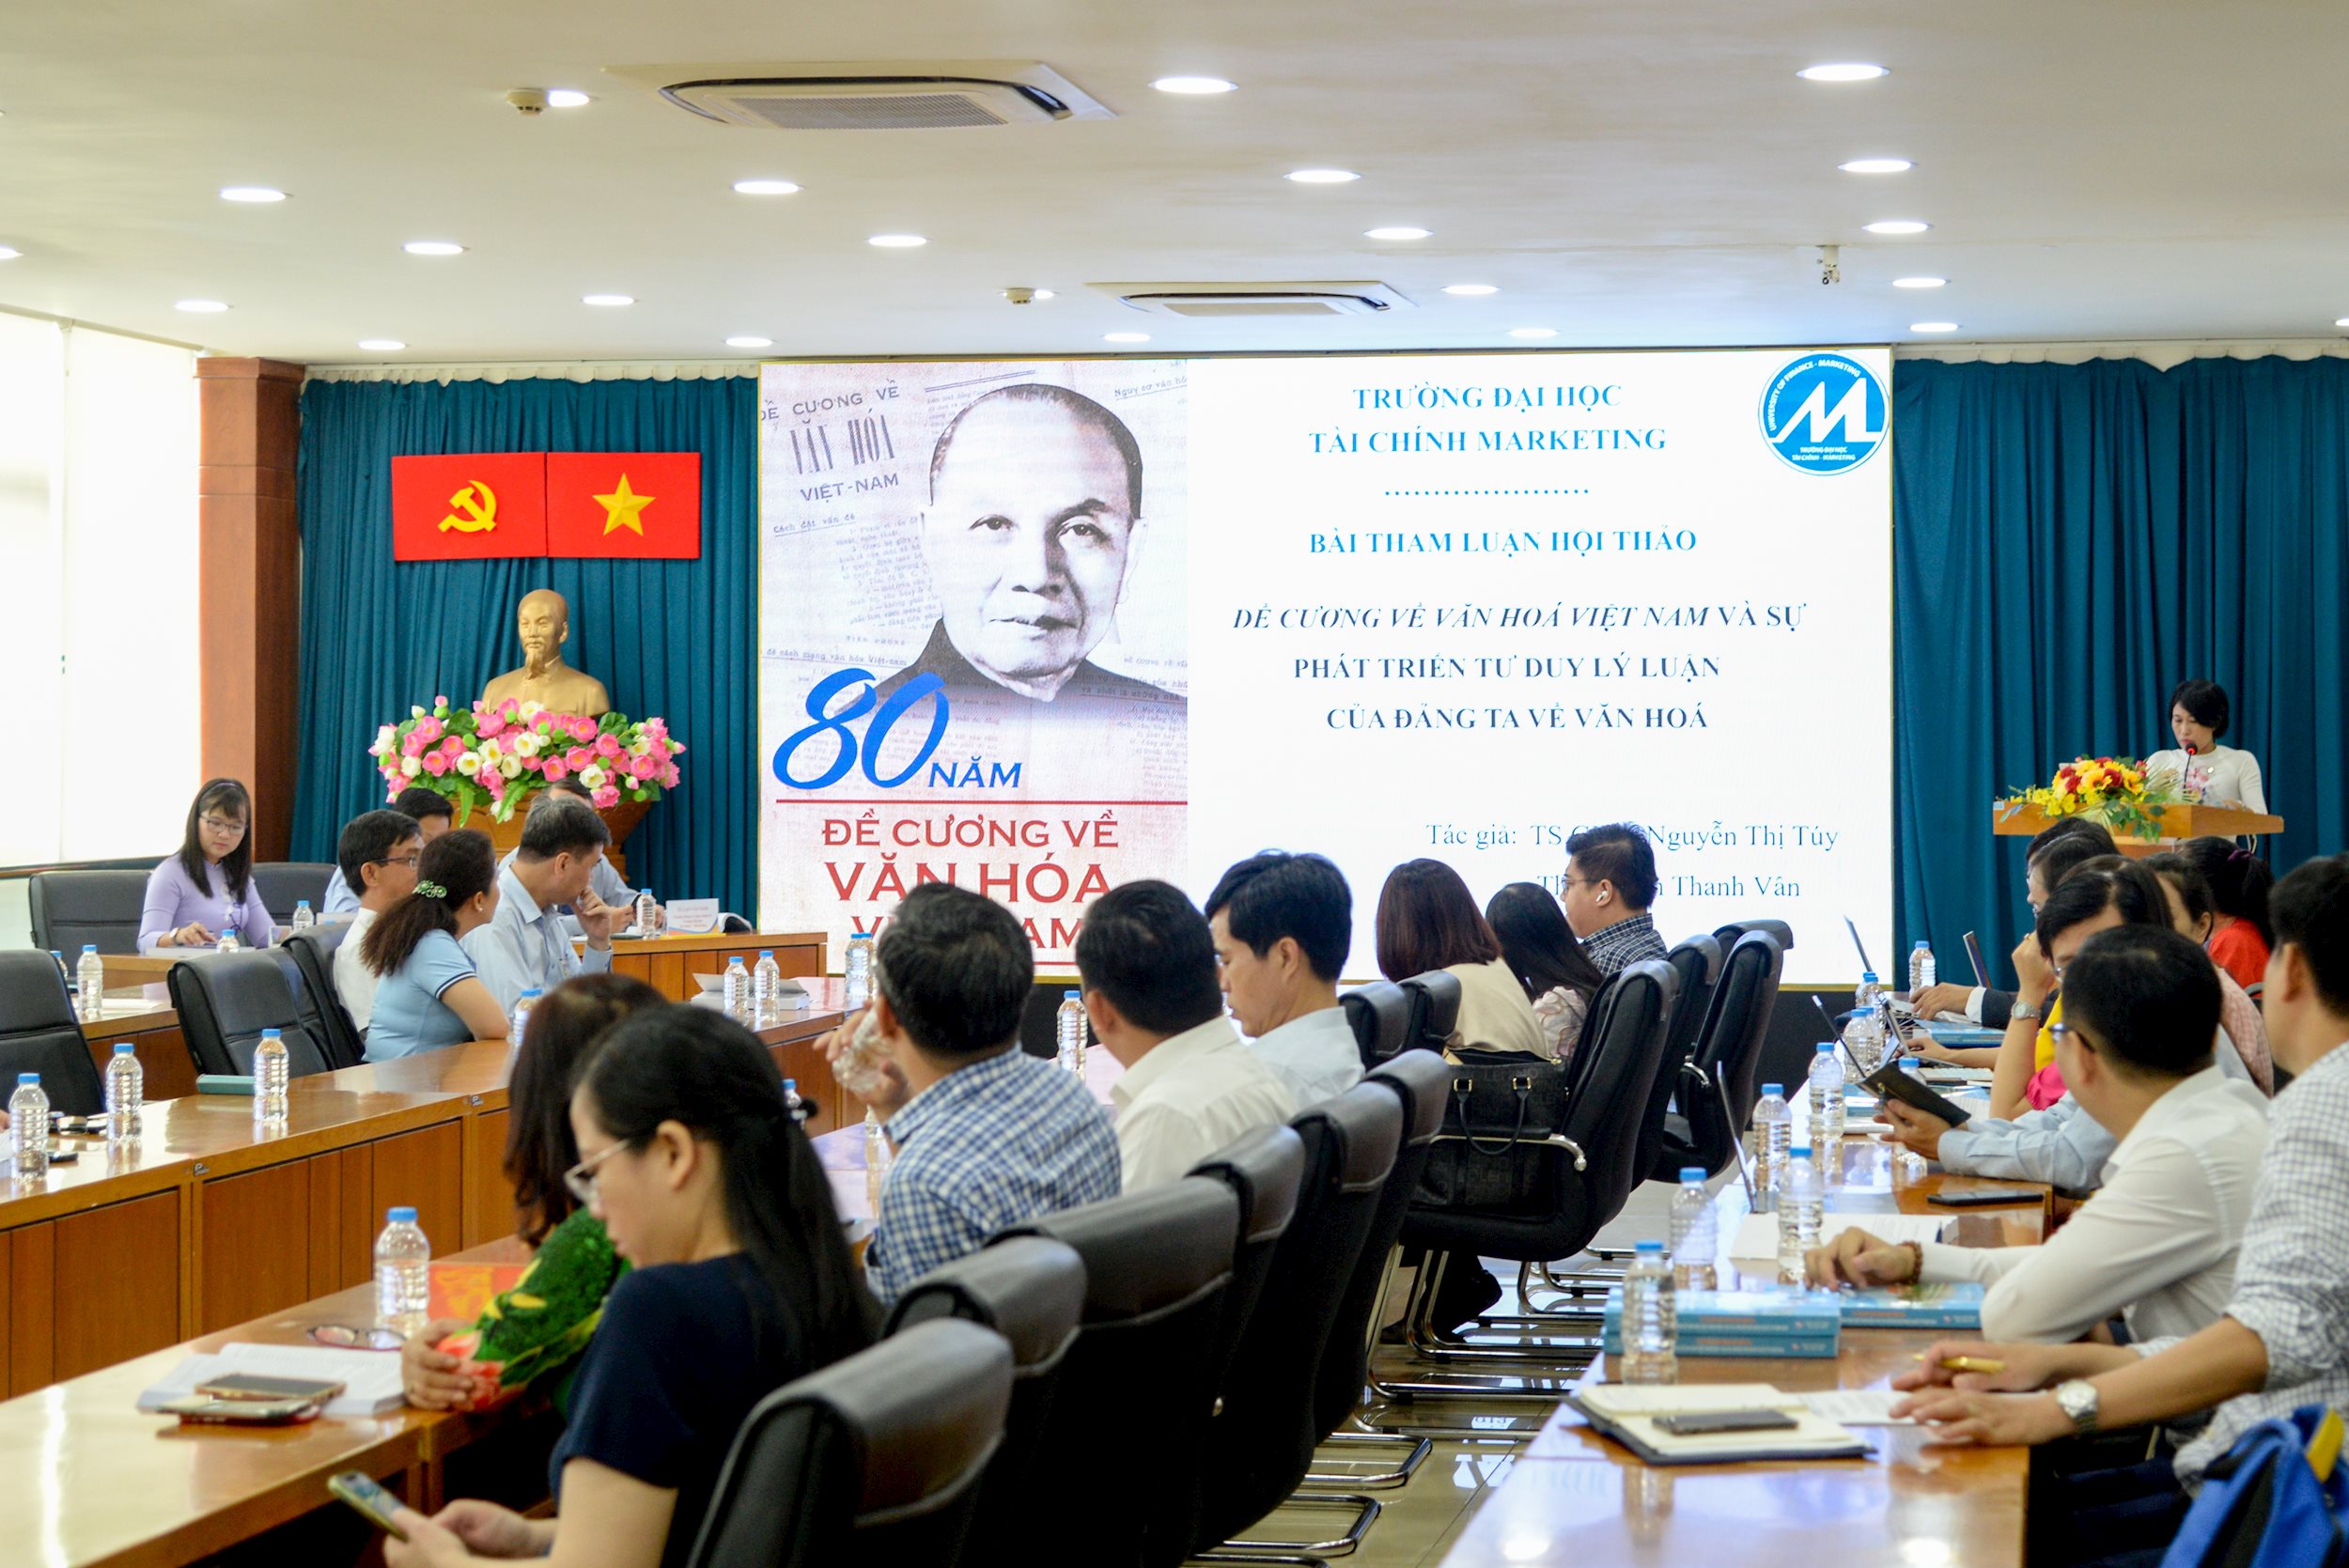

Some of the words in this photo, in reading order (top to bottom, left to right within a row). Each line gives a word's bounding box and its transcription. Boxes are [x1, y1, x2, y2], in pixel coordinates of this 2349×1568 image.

[793, 393, 863, 415] CƯƠNG
[876, 378, 900, 401] VỀ
[1353, 381, 1483, 410] TRƯỜNG
[1493, 386, 1545, 413] ĐẠI
[1555, 384, 1622, 413] HỌC
[1308, 427, 1359, 454] TÀI
[1369, 426, 1467, 453] CHÍNH
[1477, 428, 1667, 452] MARKETING
[800, 473, 900, 504] VIỆT-NAM
[1309, 525, 1357, 552] BÀI
[1366, 532, 1452, 552] THAM
[1462, 527, 1541, 559] LUẬN
[1551, 526, 1604, 557] HỘI
[1612, 520, 1698, 551] THẢO
[1280, 605, 1382, 628] CƯƠNG
[1392, 602, 1426, 628] VỀ
[1437, 603, 1493, 628] VĂN
[1500, 601, 1563, 627] HOÁ
[1573, 604, 1639, 631] VIỆT
[1643, 606, 1710, 627] NAM
[1718, 599, 1757, 626] VÀ
[1767, 601, 1808, 631] SỰ
[1295, 653, 1371, 678] PHÁT
[1378, 652, 1466, 678] TRIỂN
[1474, 654, 1518, 678] TƯ
[1526, 658, 1585, 678] DUY
[1594, 651, 1631, 677] LÝ
[1641, 653, 1719, 683] LUẬN
[772, 668, 949, 790] 80
[928, 755, 1023, 788] NĂM
[1326, 704, 1387, 730] CỦA
[1394, 702, 1477, 730] ĐẢNG
[1485, 707, 1520, 729] TA
[1528, 702, 1566, 729] VỀ
[1575, 702, 1635, 728] VĂN
[1645, 701, 1708, 728] HOÁ
[821, 808, 880, 846] ĐỀ
[892, 814, 1050, 847] CƯƠNG
[1063, 809, 1120, 848] VỀ
[1425, 823, 1468, 846] Tác
[1648, 820, 1737, 854] Nguyễn
[1745, 824, 1784, 849] Thị
[1792, 825, 1840, 852] Túy
[978, 852, 1112, 904] HÓA
[1672, 875, 1745, 897] Thanh
[1753, 875, 1800, 897] Vân
[1022, 917, 1082, 950] AM
